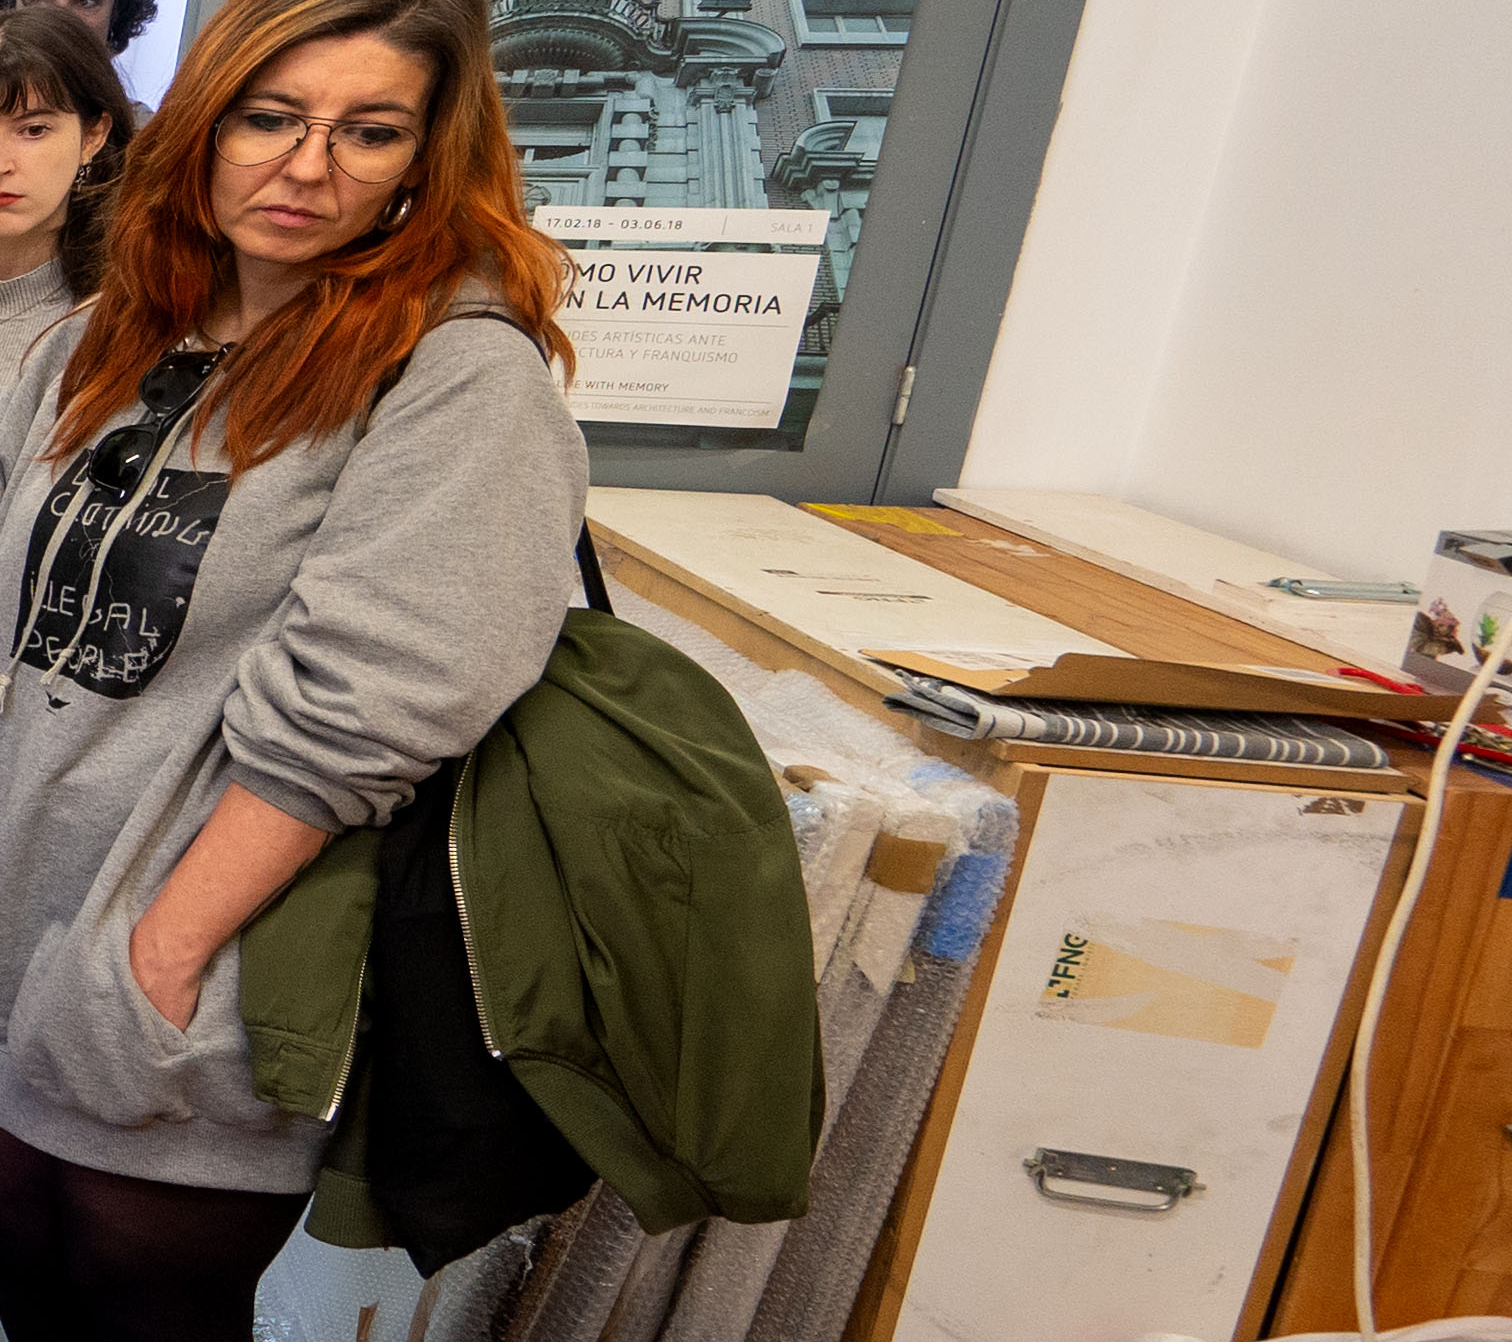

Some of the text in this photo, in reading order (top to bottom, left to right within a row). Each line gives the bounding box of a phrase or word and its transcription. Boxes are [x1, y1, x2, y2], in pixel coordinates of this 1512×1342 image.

[545, 217, 602, 229] 17.02.18
[620, 217, 684, 231] 03.06.18
[770, 221, 803, 234] SALA
[628, 263, 703, 285] VIVIR
[596, 290, 631, 310] LA
[642, 292, 782, 316] MEMORIA
[603, 329, 684, 346] ARTÍSTICAS
[687, 334, 728, 347] ANTE
[630, 349, 640, 360] Y
[641, 349, 739, 364] FRANQUISMO
[584, 379, 615, 391] WITH
[618, 381, 670, 393] MEMORY
